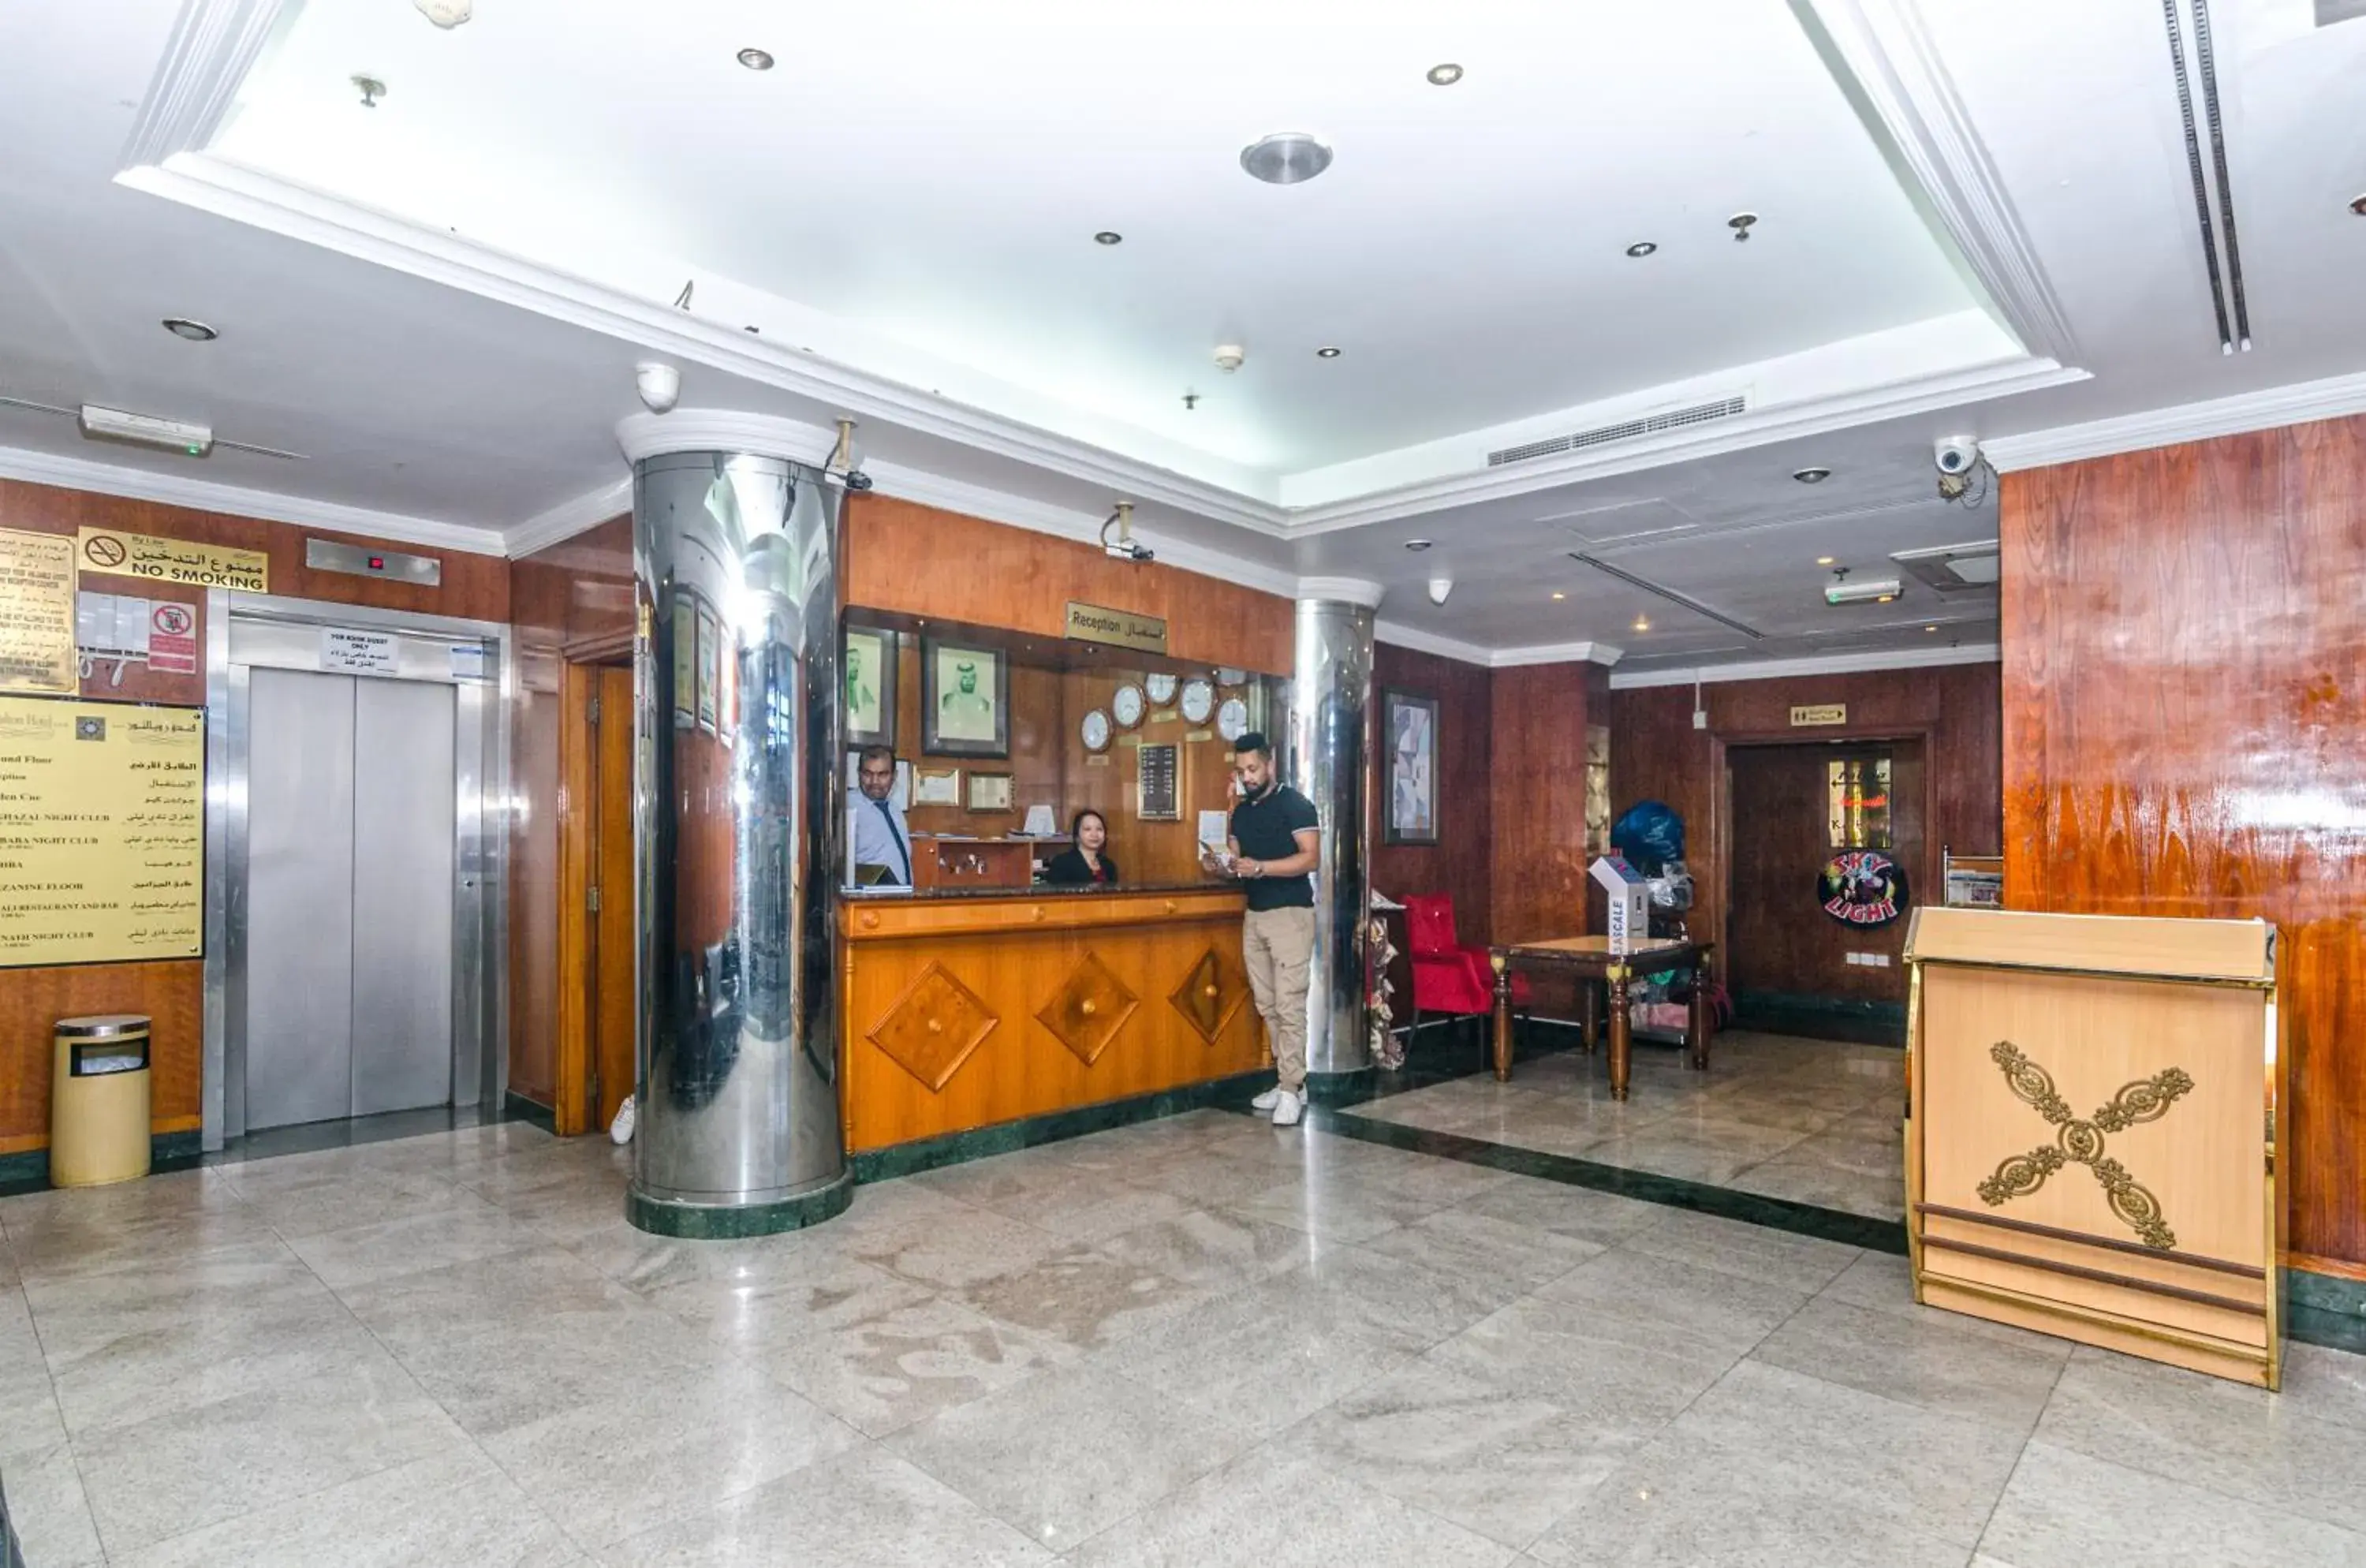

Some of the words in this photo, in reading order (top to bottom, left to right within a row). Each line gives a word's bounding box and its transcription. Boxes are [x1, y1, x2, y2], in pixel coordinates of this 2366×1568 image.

[132, 547, 207, 565] التدخين
[132, 562, 164, 577] NO
[170, 567, 263, 590] SMOKING
[1073, 610, 1121, 633] Reception
[24, 755, 52, 763] Floor
[19, 902, 80, 911] RESTAURANT
[1824, 895, 1898, 924] LIGHT
